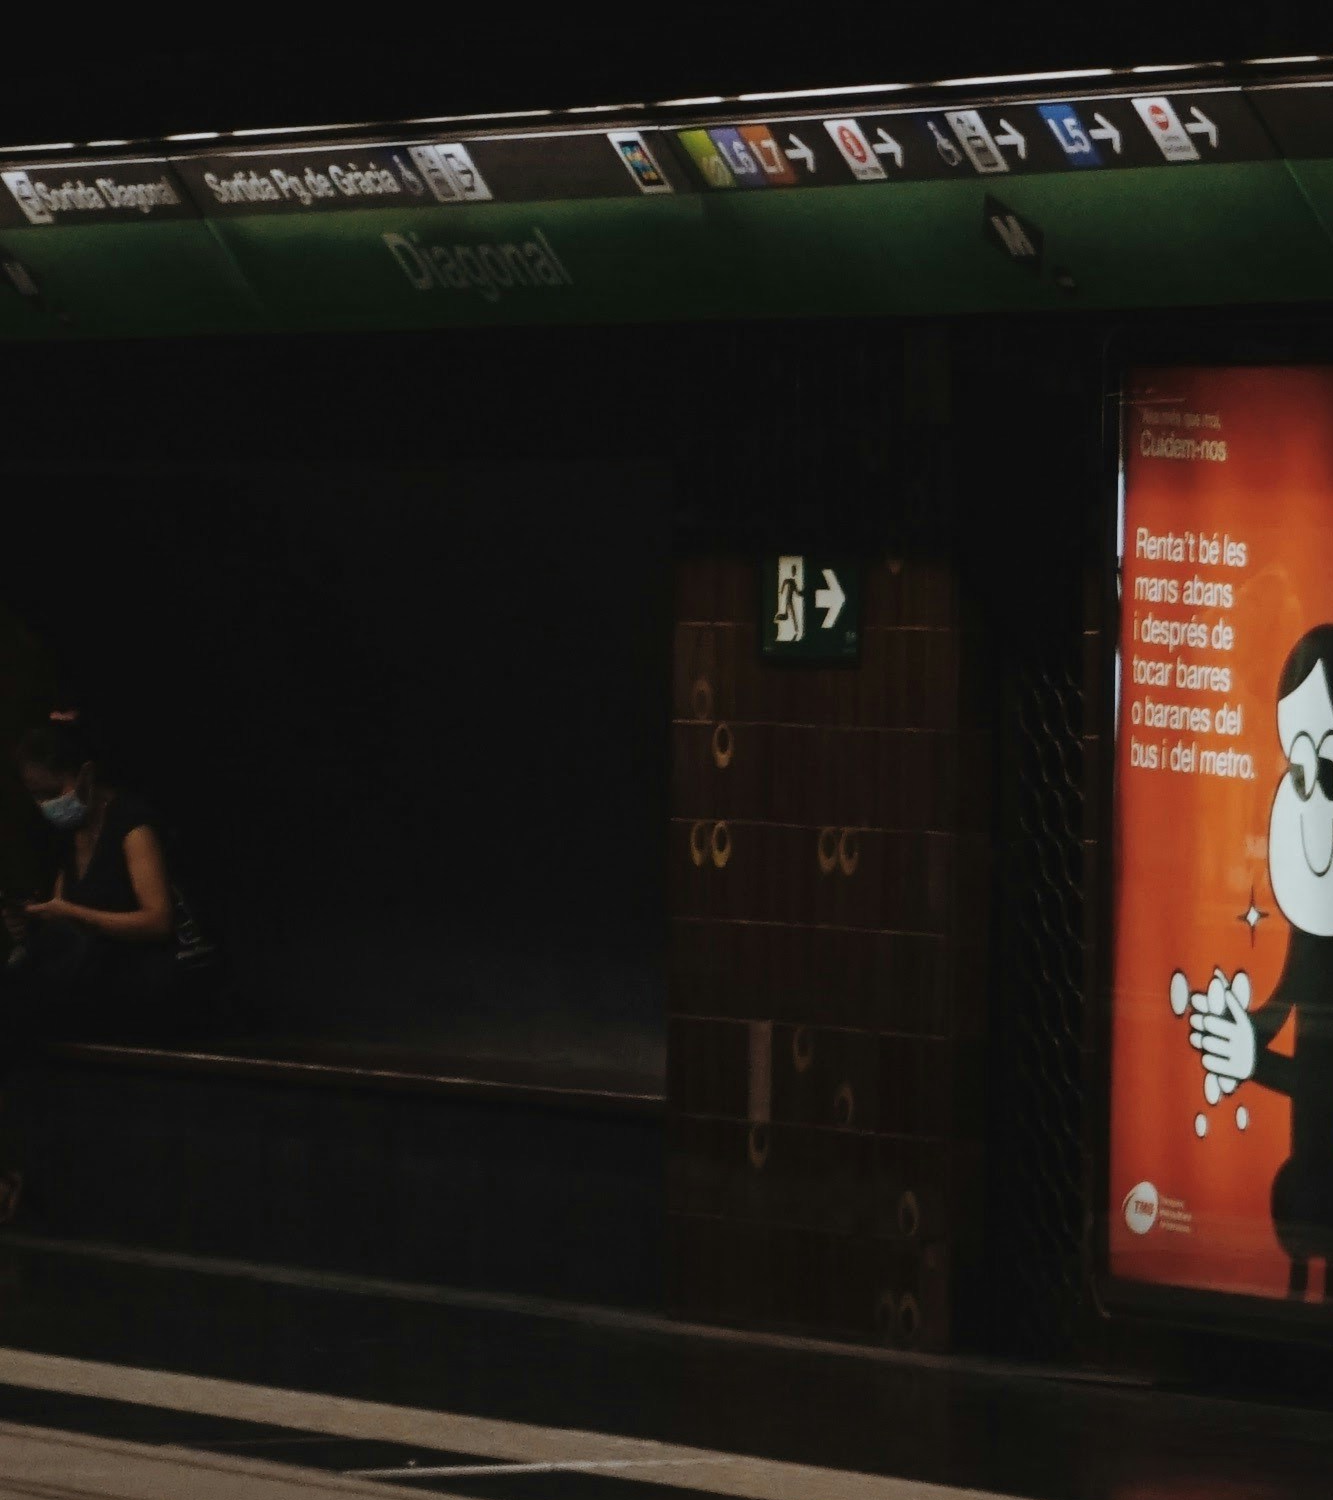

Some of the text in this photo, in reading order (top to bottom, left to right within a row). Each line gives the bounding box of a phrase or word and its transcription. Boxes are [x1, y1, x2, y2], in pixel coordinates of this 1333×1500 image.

[1045, 117, 1092, 155] L5
[718, 140, 759, 175] L6
[749, 138, 785, 175] L7
[204, 170, 280, 204] Sortida
[990, 213, 1037, 257] M
[382, 226, 573, 302] Diagonal
[1198, 530, 1220, 564] bé
[1222, 533, 1248, 568] les
[1134, 575, 1234, 609] mans abans
[1141, 612, 1208, 654] després
[1211, 617, 1234, 651] de
[1132, 655, 1231, 692] tocar barres
[1132, 695, 1242, 735] o baranes del
[1130, 735, 1159, 769] bus
[1169, 740, 1197, 773] del
[1199, 748, 1256, 780] metro.
